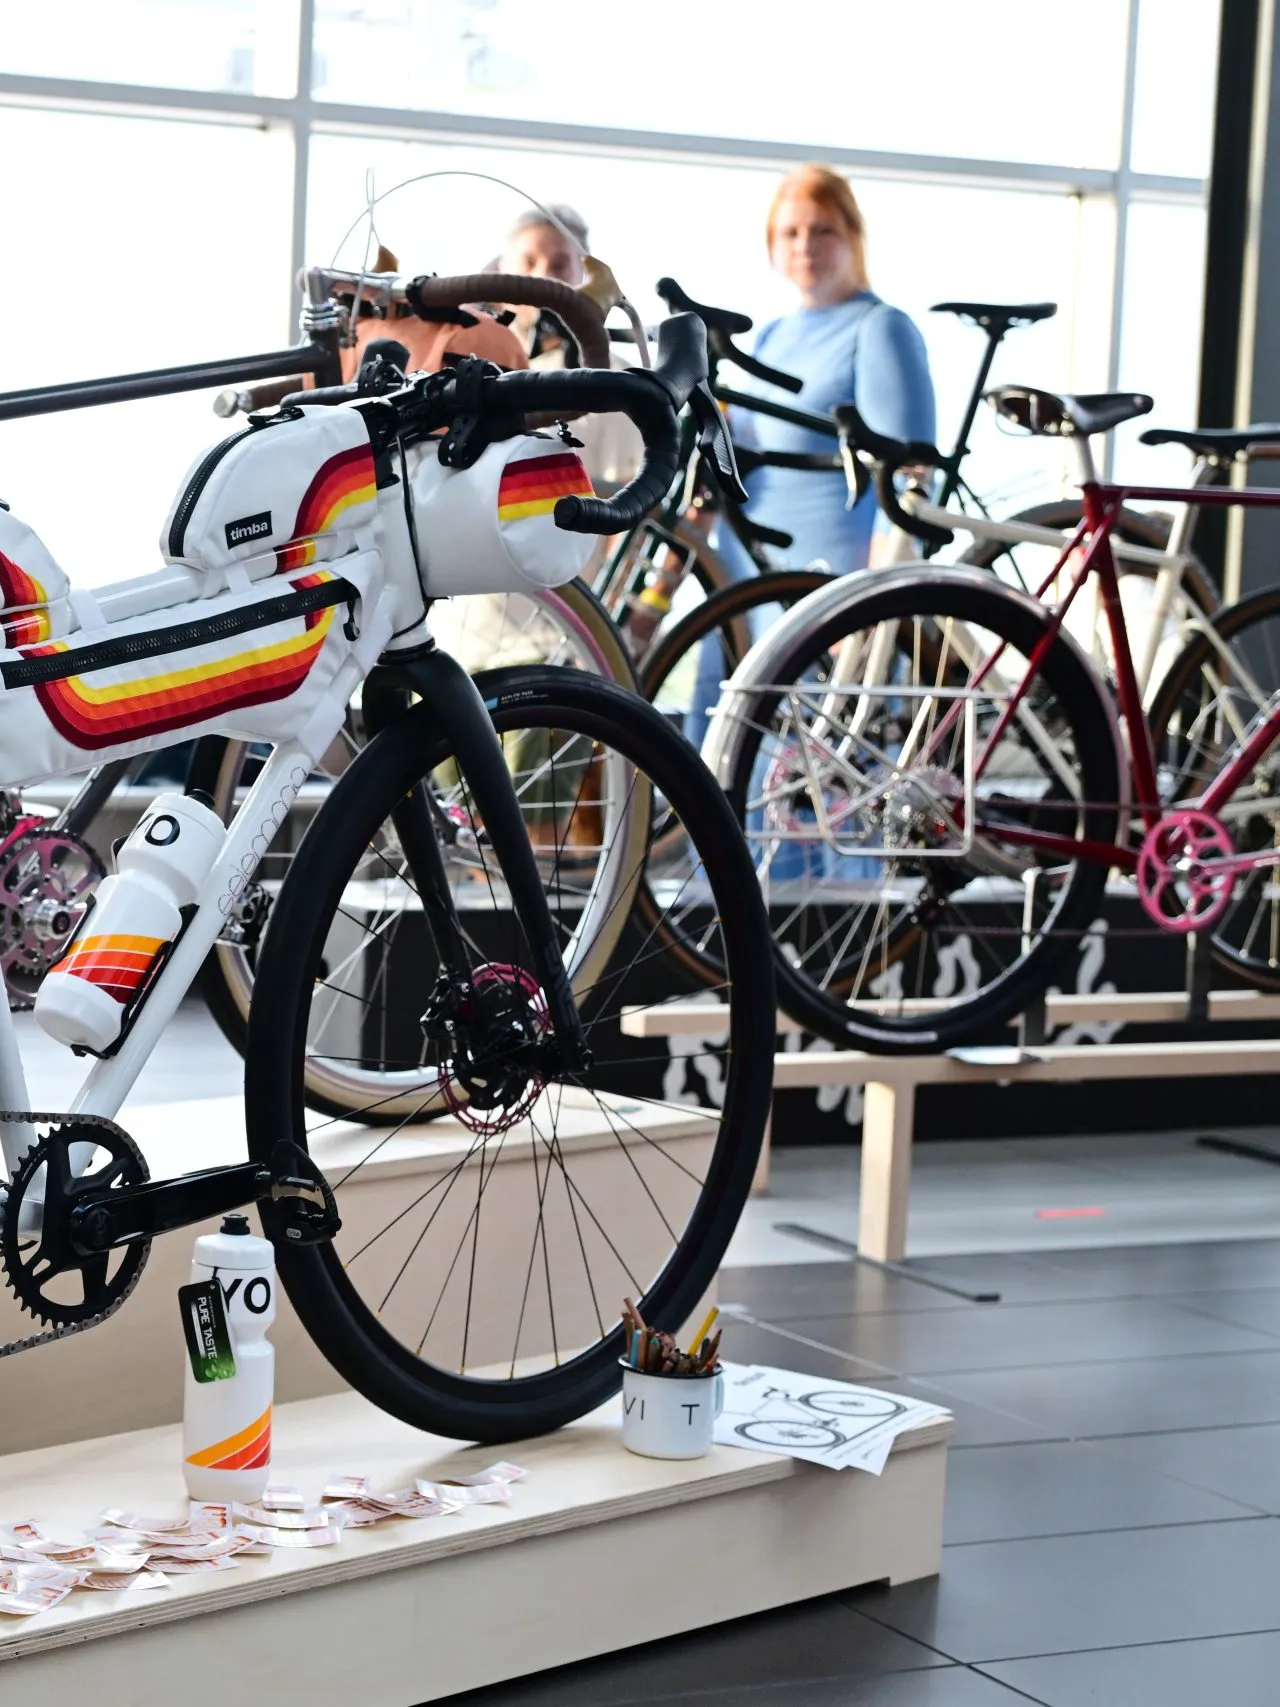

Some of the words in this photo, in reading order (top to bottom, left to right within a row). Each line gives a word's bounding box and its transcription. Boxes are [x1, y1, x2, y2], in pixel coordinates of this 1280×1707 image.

[230, 522, 268, 540] timba
[197, 1296, 211, 1325] PURE
[203, 1327, 219, 1360] TASTE
